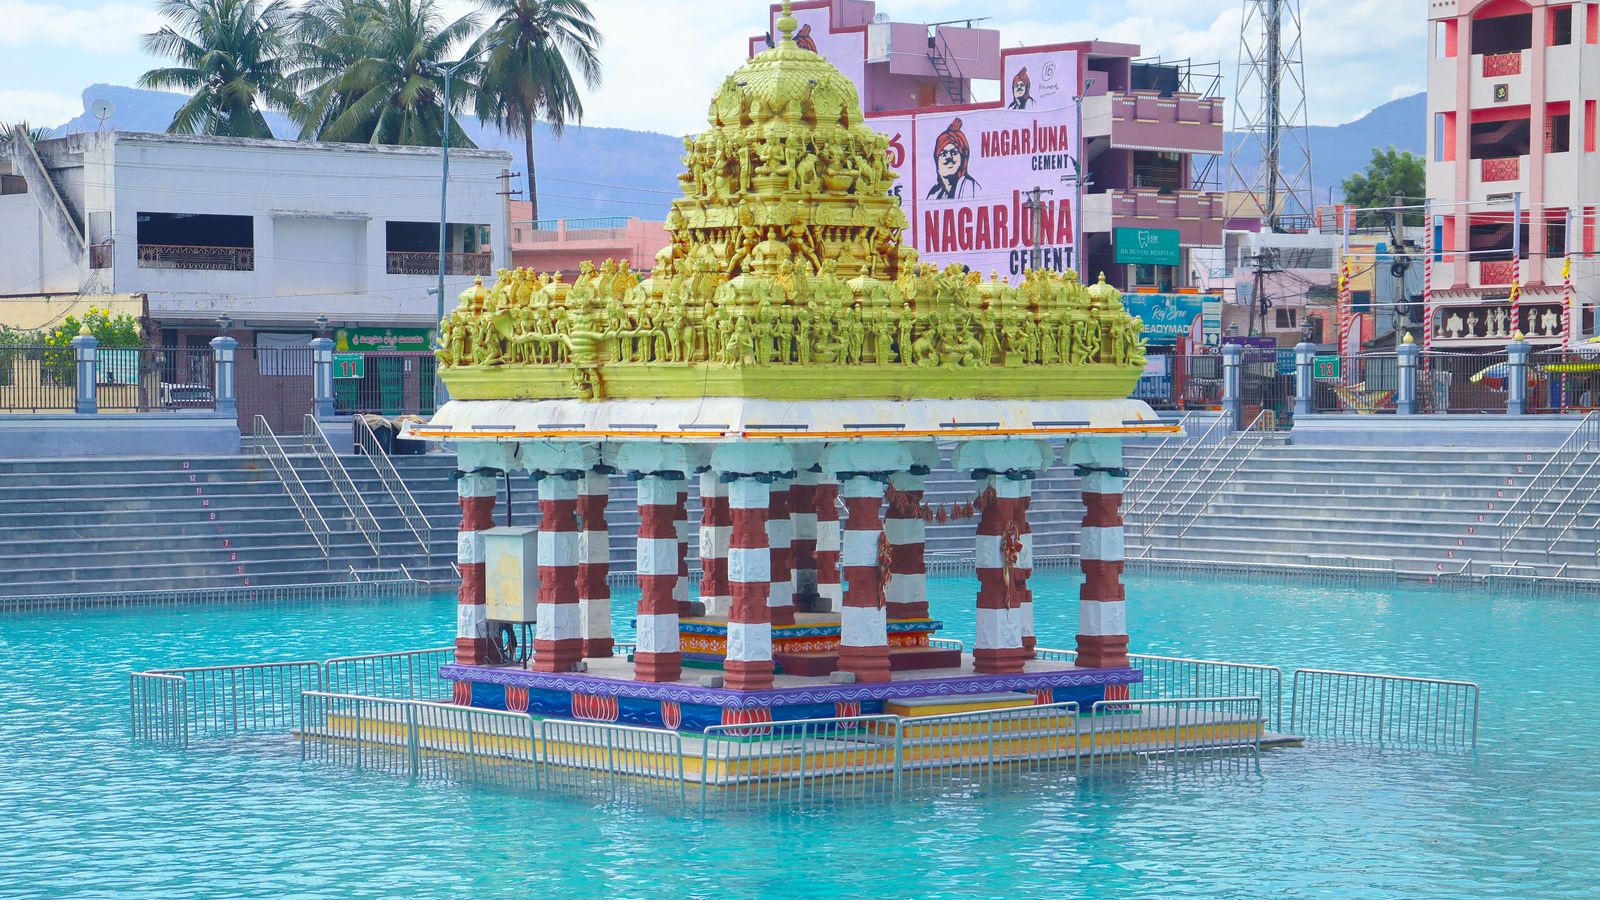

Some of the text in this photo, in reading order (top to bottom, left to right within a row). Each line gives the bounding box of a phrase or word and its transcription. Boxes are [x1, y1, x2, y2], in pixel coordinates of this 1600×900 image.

[981, 119, 1069, 158] NAGARJUNA
[1031, 154, 1069, 171] CEMENT
[925, 189, 1073, 253] NAGARJUNA
[1129, 248, 1149, 256] DENTAL
[1150, 249, 1176, 257] HOSPITAL
[1151, 304, 1167, 321] Raj
[1142, 324, 1193, 333] EADYMAD
[341, 361, 357, 376] 11
[1320, 362, 1333, 376] 13
